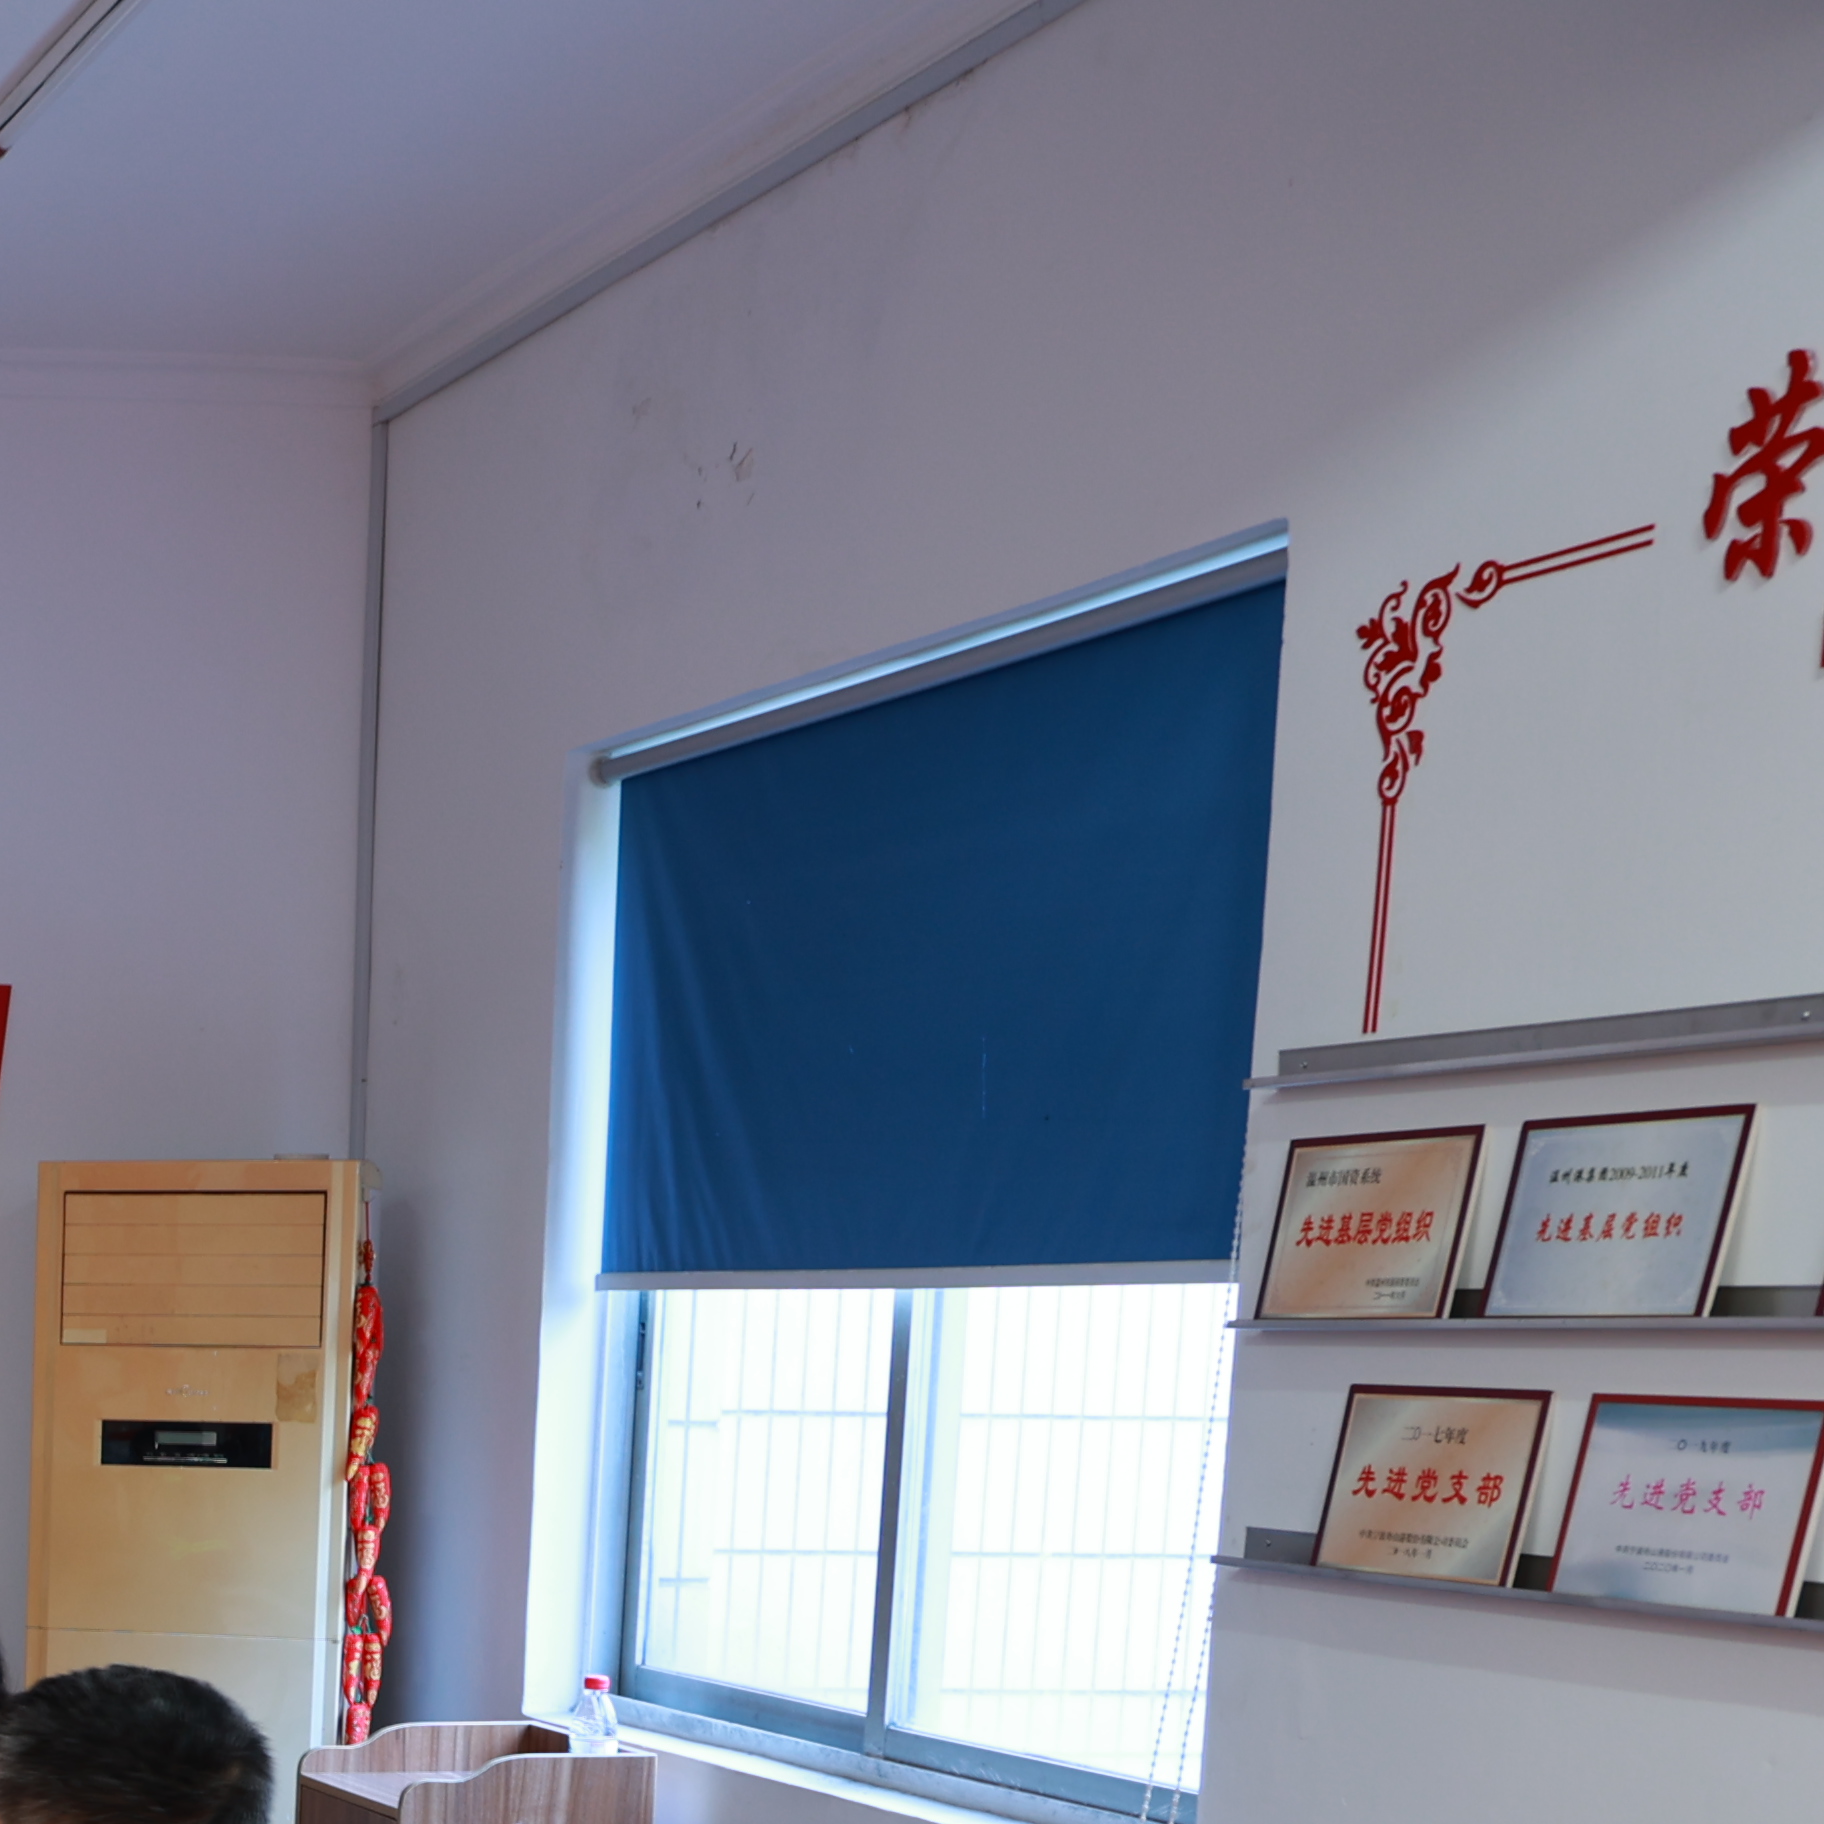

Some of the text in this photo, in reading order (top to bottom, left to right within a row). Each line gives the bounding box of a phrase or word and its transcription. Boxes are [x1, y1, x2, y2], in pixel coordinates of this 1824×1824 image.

[1295, 1209, 1435, 1249] 先进基层党组织
[1536, 1211, 1686, 1243] 先进基层党组织
[1351, 1463, 1506, 1509] 先进党支部
[1608, 1472, 1768, 1521] 先进党支部
